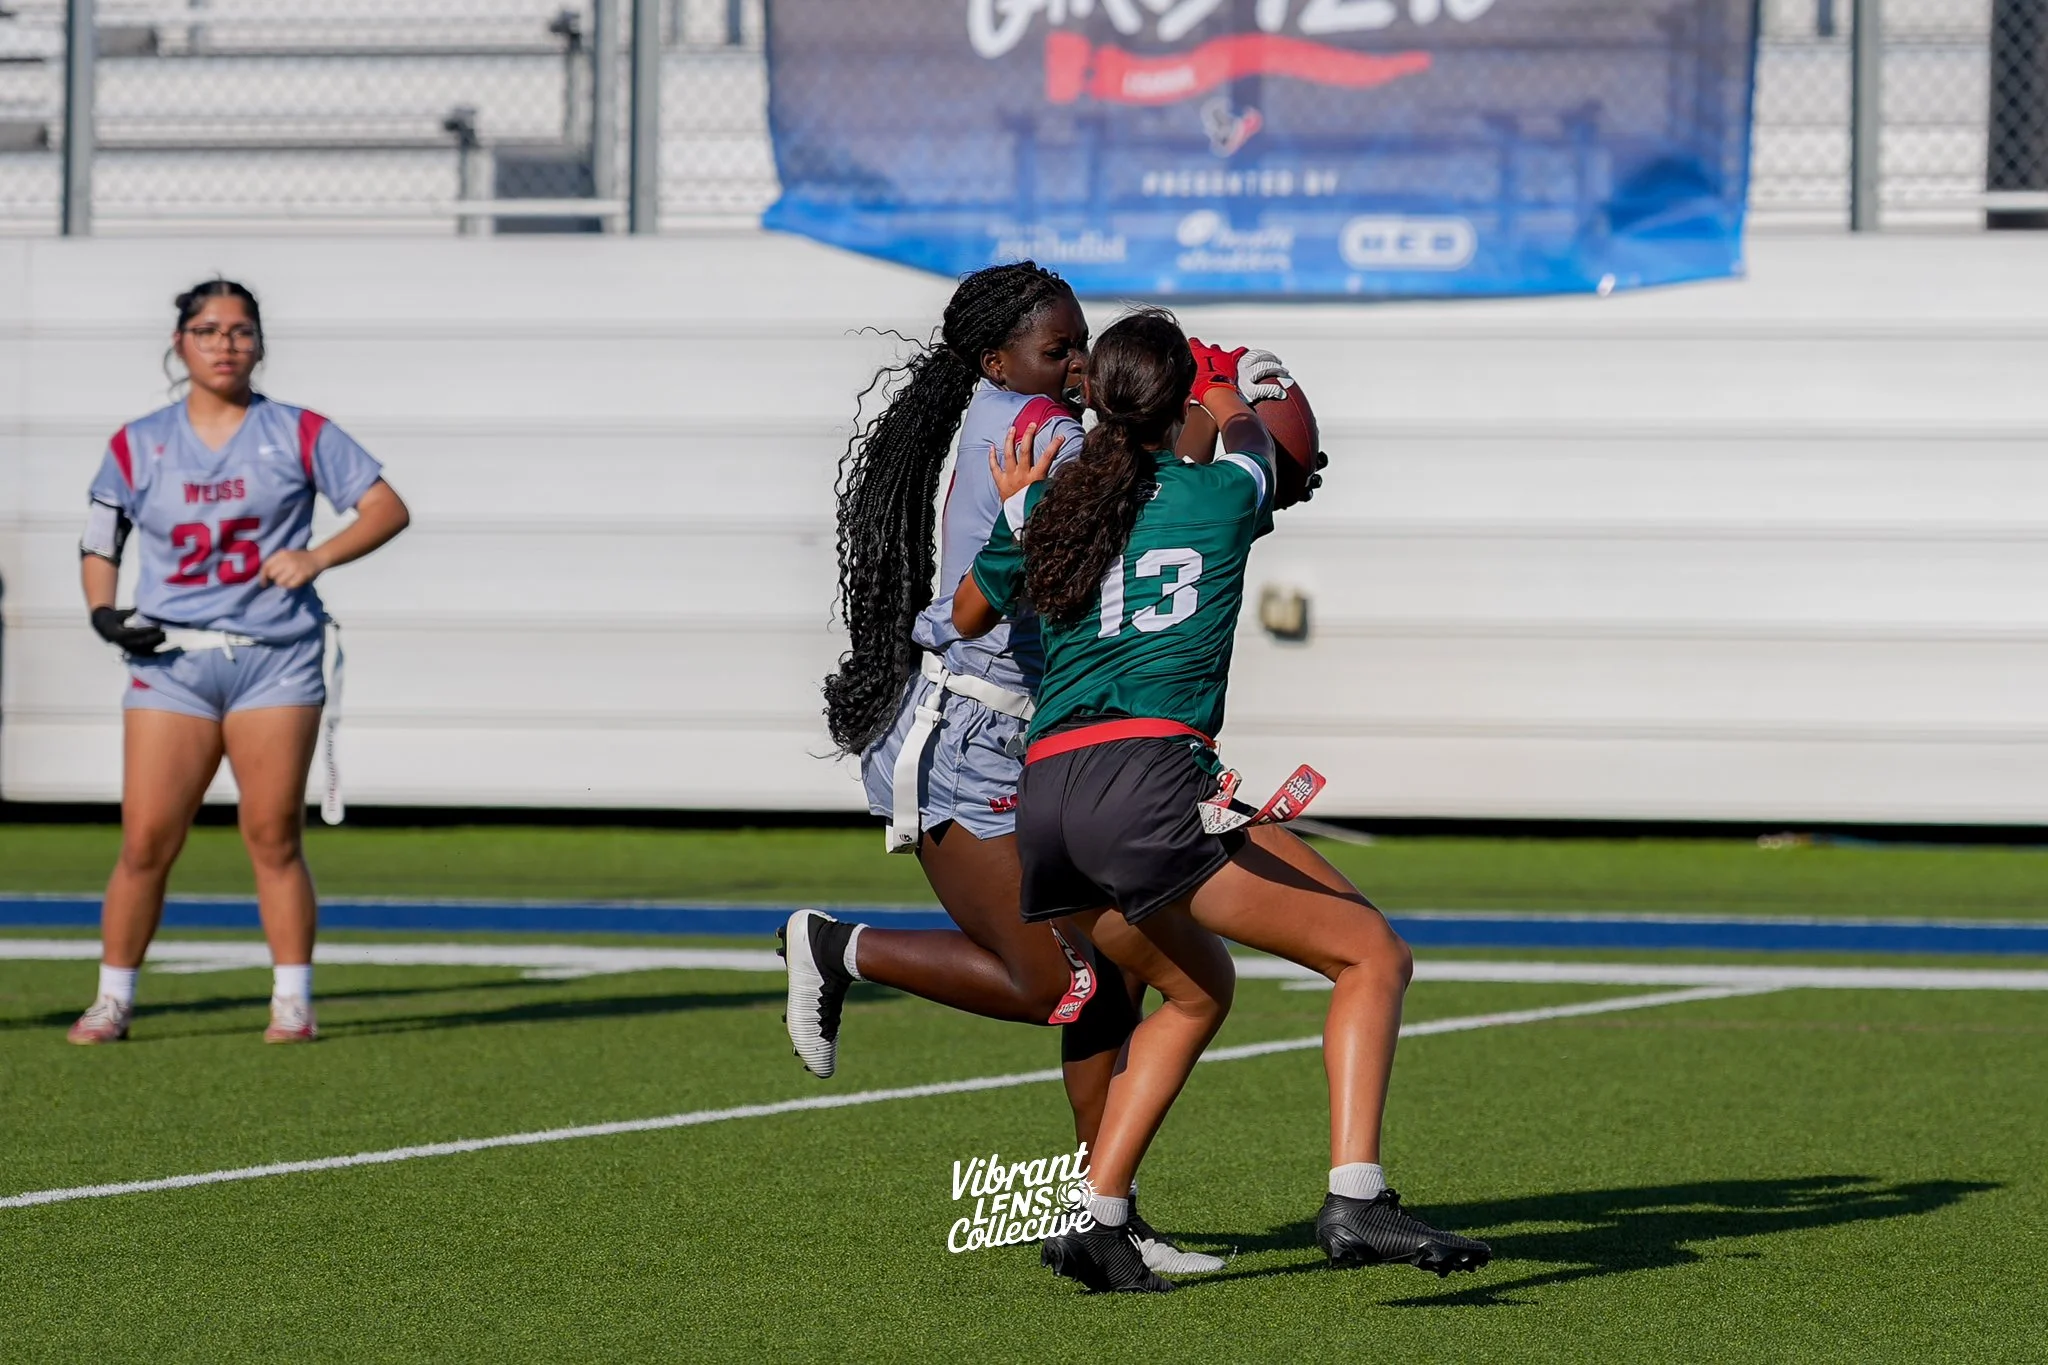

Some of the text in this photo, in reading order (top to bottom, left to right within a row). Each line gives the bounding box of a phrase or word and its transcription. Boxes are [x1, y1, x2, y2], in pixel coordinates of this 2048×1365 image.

[184, 478, 245, 504] WEISS
[164, 517, 261, 586] 25
[1098, 548, 1203, 638] 13
[1284, 782, 1307, 804] TEXAS
[1290, 776, 1313, 798] FURY
